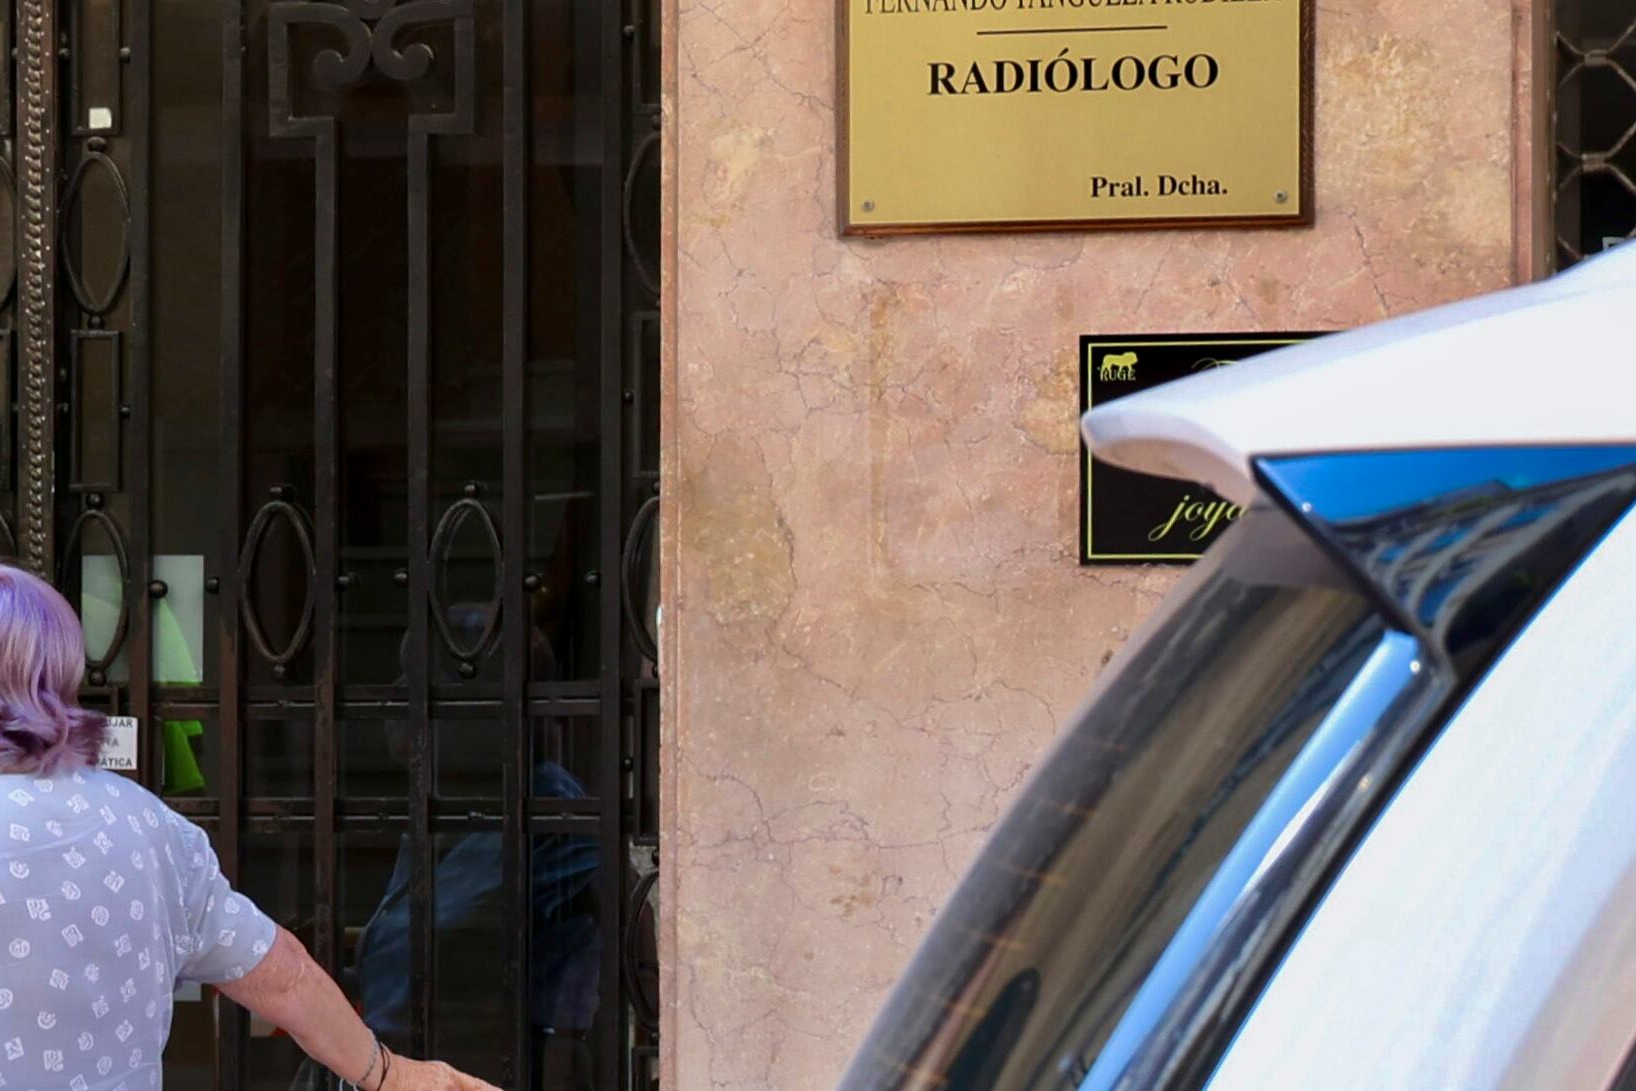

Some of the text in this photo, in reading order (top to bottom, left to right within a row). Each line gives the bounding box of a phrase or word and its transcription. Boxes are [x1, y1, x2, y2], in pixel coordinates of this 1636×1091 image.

[927, 47, 1219, 95] RADIÓLOGO
[1091, 174, 1228, 198] Pral. Dcha.
